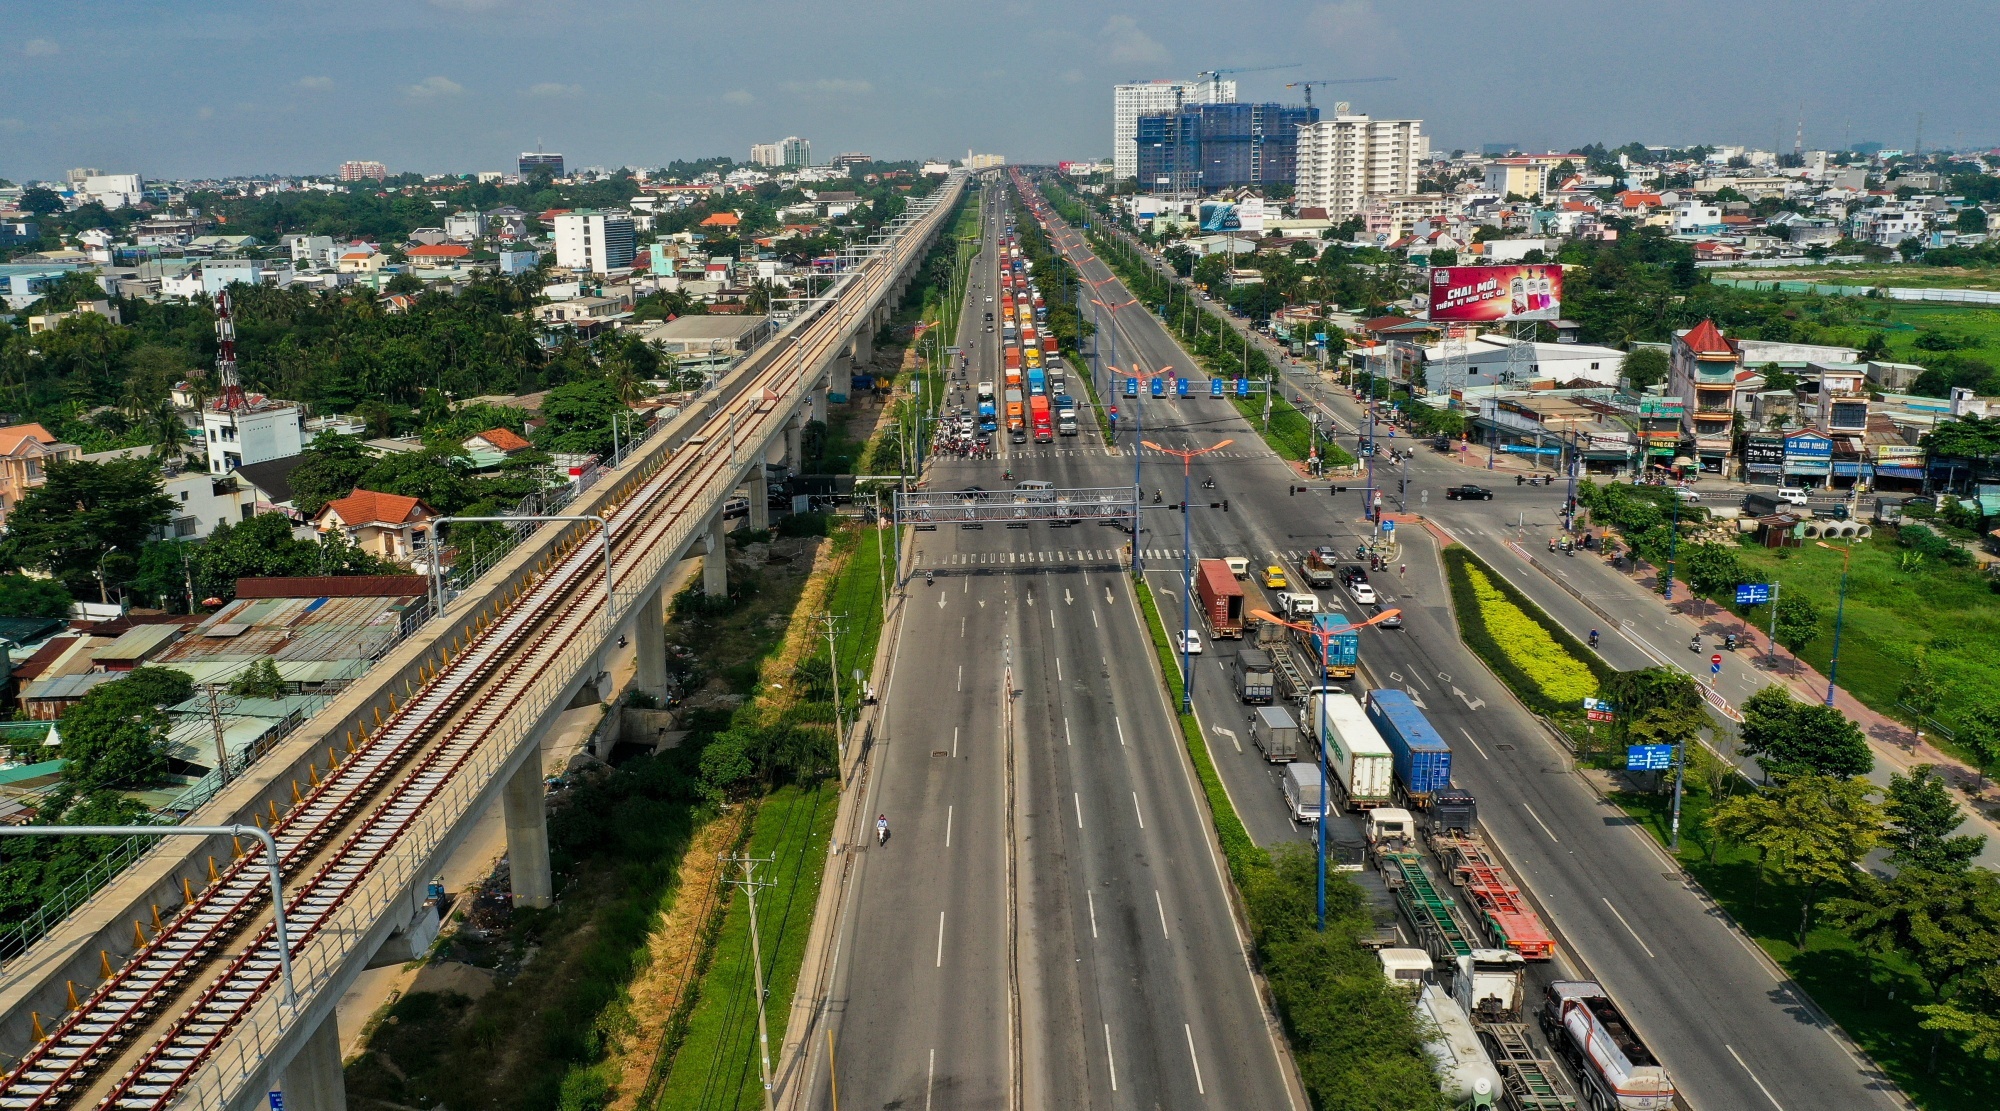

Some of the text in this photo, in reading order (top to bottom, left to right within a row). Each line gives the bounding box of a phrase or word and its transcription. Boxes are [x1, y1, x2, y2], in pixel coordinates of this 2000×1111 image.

[1448, 278, 1497, 300] CHAI MỚI
[1436, 300, 1454, 310] THÊM
[1788, 440, 1797, 448] CÁ
[1811, 441, 1829, 451] NHẬT
